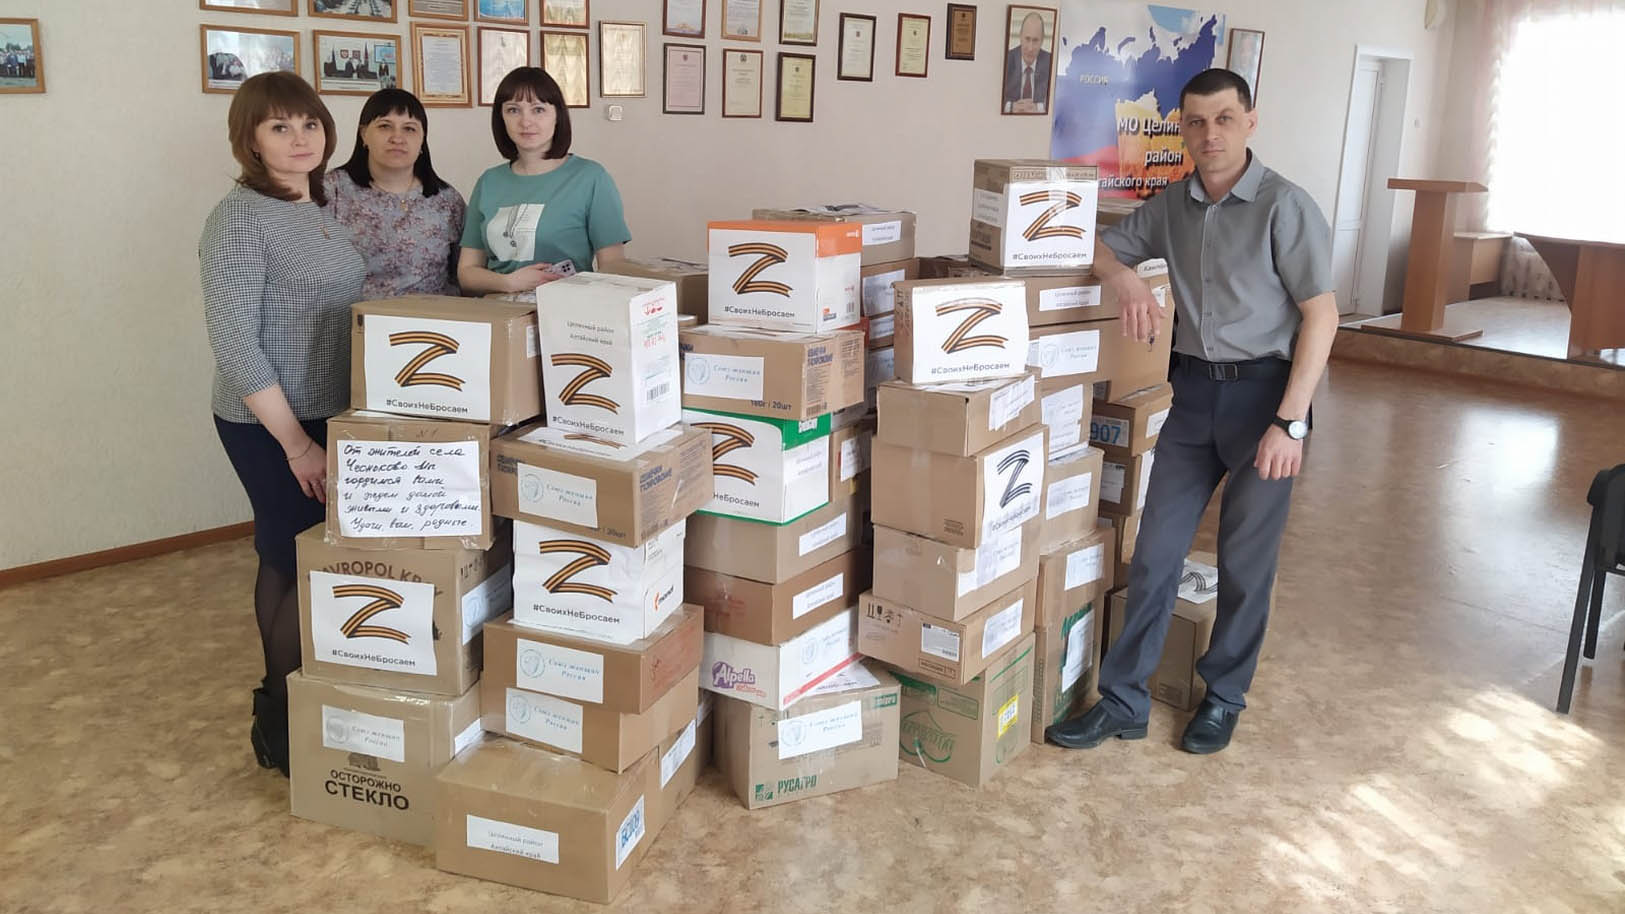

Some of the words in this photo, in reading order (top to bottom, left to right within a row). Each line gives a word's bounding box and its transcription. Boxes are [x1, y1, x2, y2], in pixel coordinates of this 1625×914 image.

[1117, 117, 1139, 134] МО
[1143, 118, 1182, 138] Целин
[1145, 149, 1183, 168] район
[1101, 174, 1143, 189] айского
[1146, 175, 1168, 190] края
[1012, 251, 1088, 262] #СвоихНеБросаем
[724, 305, 795, 319] #СвоихНеБросаем
[931, 363, 1010, 376] #СвоихНеБросаем
[386, 398, 469, 415] #СвоихНеБросаем
[552, 416, 625, 437] #СвоихНеБросаем
[344, 444, 362, 455] От
[429, 448, 465, 457] села
[344, 492, 352, 500] и
[713, 492, 760, 508] НеБросаем
[400, 506, 410, 514] и
[533, 603, 620, 625] #СвоихНеБросаем
[332, 649, 416, 668] #СвоихНеБросаем
[712, 661, 756, 689] Alpella
[330, 769, 402, 793] ОСТОРОЖНО
[777, 774, 818, 794] РУСАГРО
[325, 779, 409, 811] СТЕКЛО
